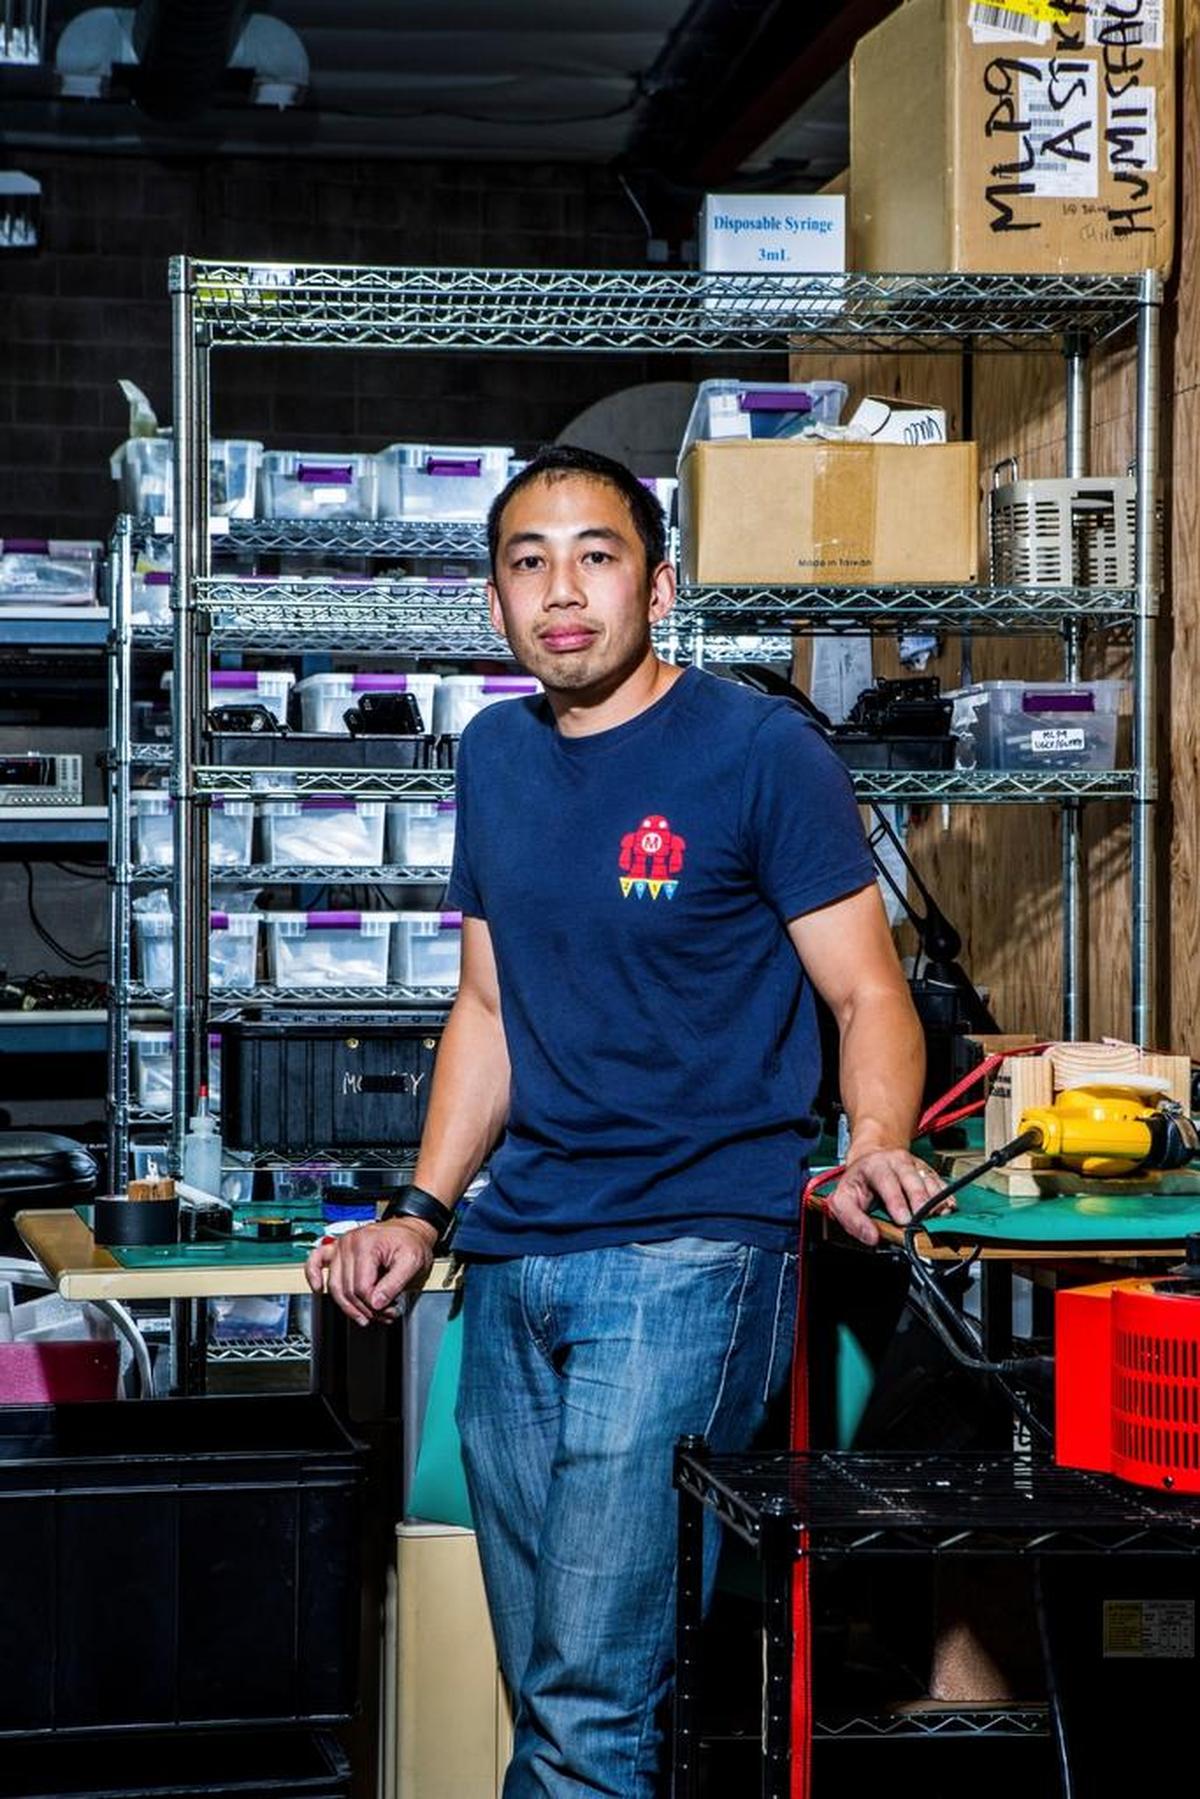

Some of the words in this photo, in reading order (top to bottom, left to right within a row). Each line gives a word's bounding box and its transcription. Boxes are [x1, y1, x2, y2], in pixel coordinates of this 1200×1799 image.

[714, 215, 781, 234] Disposable
[784, 216, 834, 234] Syringe
[758, 248, 791, 261] 3mL
[644, 836, 659, 849] M
